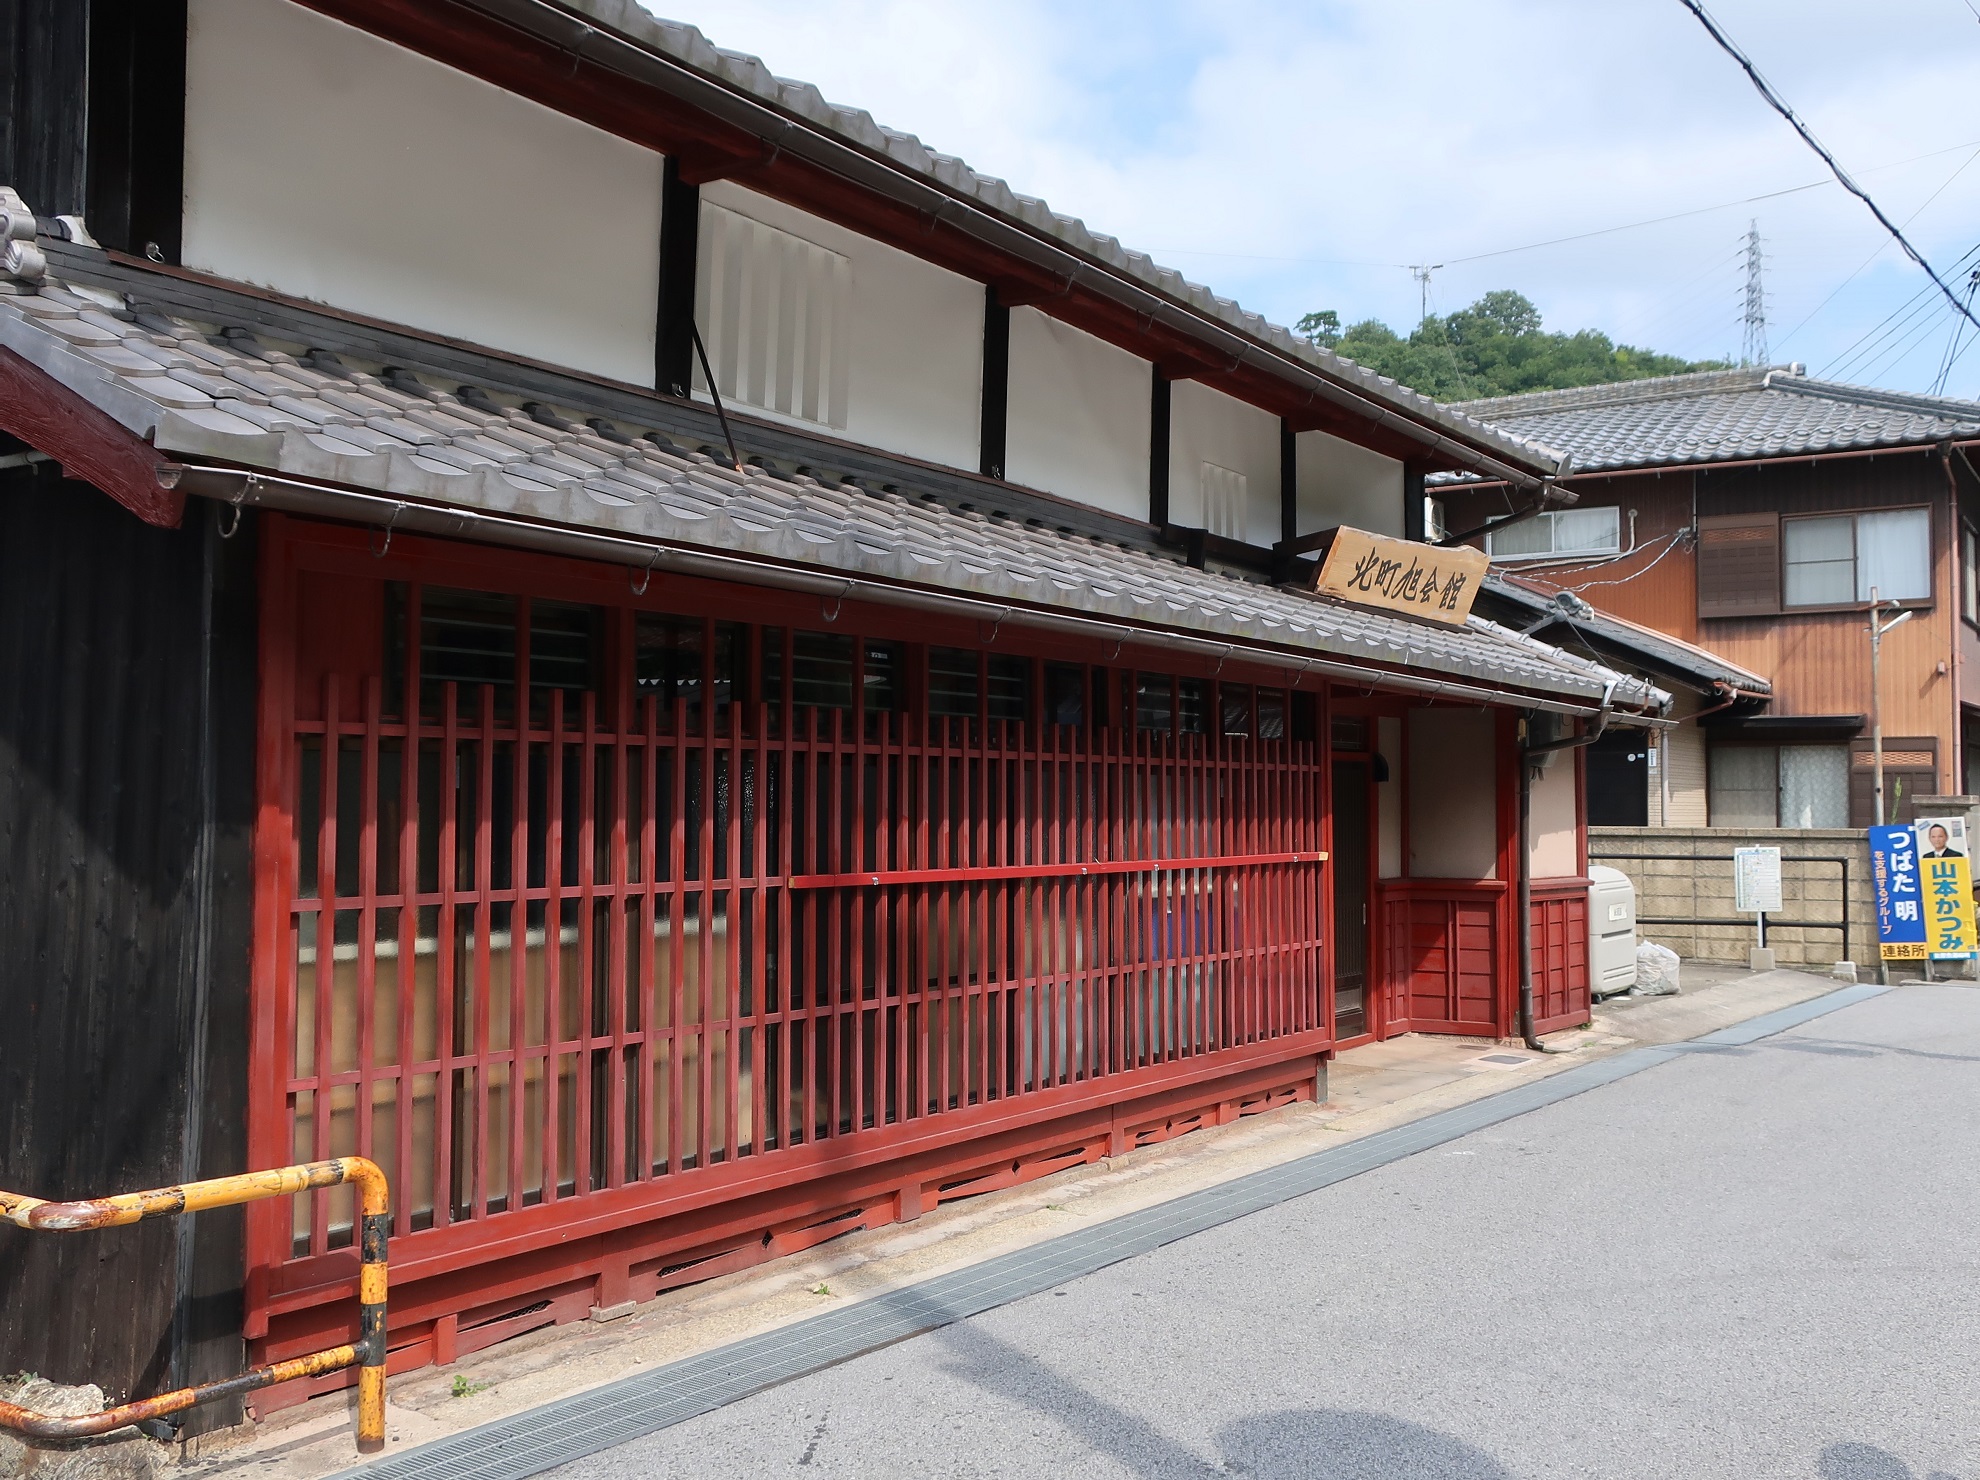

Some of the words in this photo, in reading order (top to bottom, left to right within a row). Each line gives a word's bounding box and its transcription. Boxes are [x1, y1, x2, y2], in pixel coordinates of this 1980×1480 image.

[1347, 546, 1467, 610] 北町旭会館
[1888, 832, 1916, 893] つばた
[1895, 900, 1918, 921] 明
[1932, 861, 1963, 950] 山本かつみ
[1883, 945, 1925, 958] 連絡所
